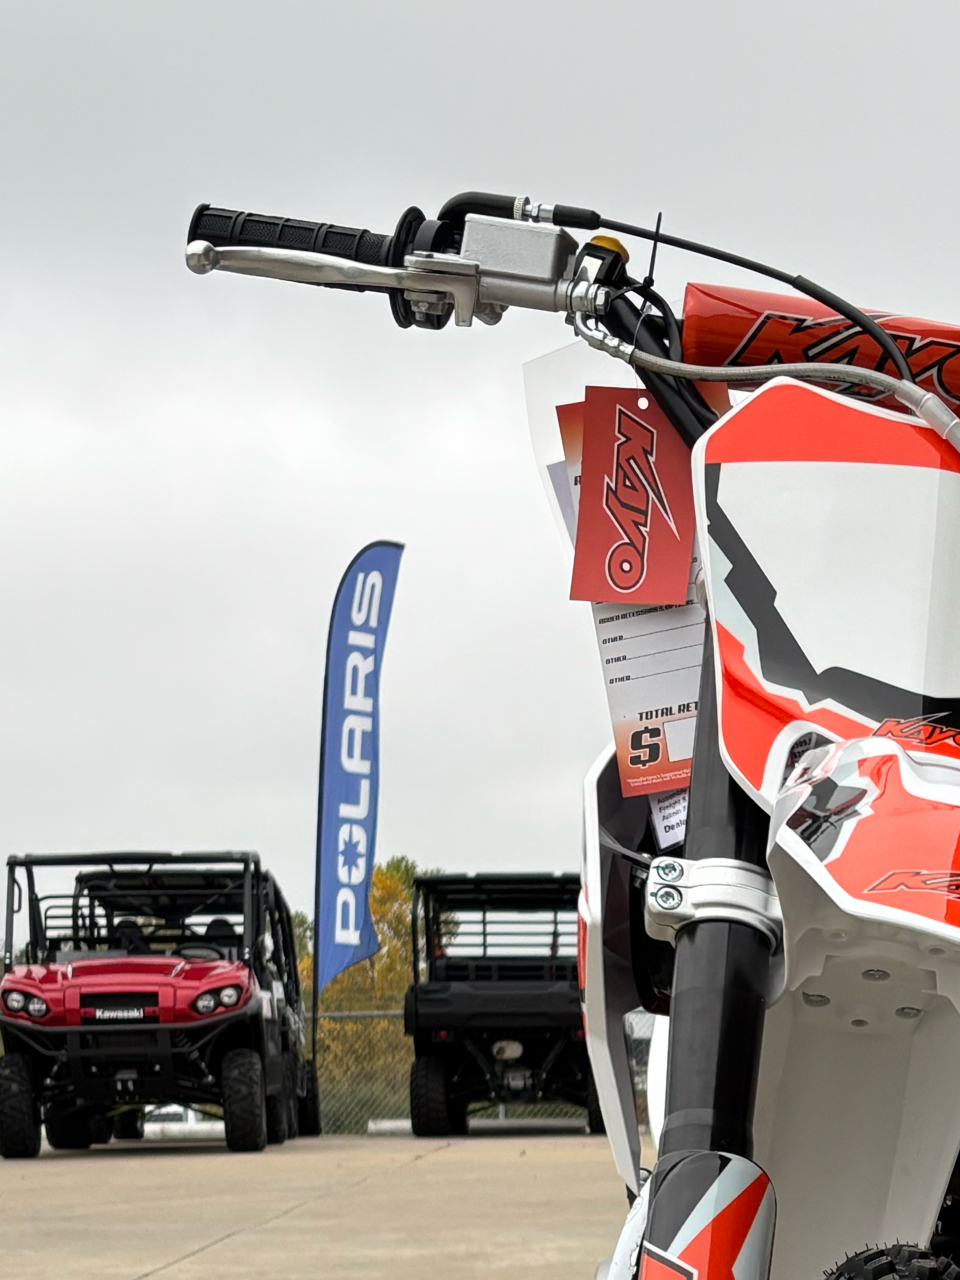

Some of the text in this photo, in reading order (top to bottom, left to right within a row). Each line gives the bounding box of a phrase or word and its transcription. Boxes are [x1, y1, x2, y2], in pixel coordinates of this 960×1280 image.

[603, 404, 680, 594] KAYO
[638, 701, 699, 722] TOTAL RET
[335, 569, 383, 946] POLARIS
[629, 726, 662, 768] $
[95, 1007, 144, 1019] Kawasaki
